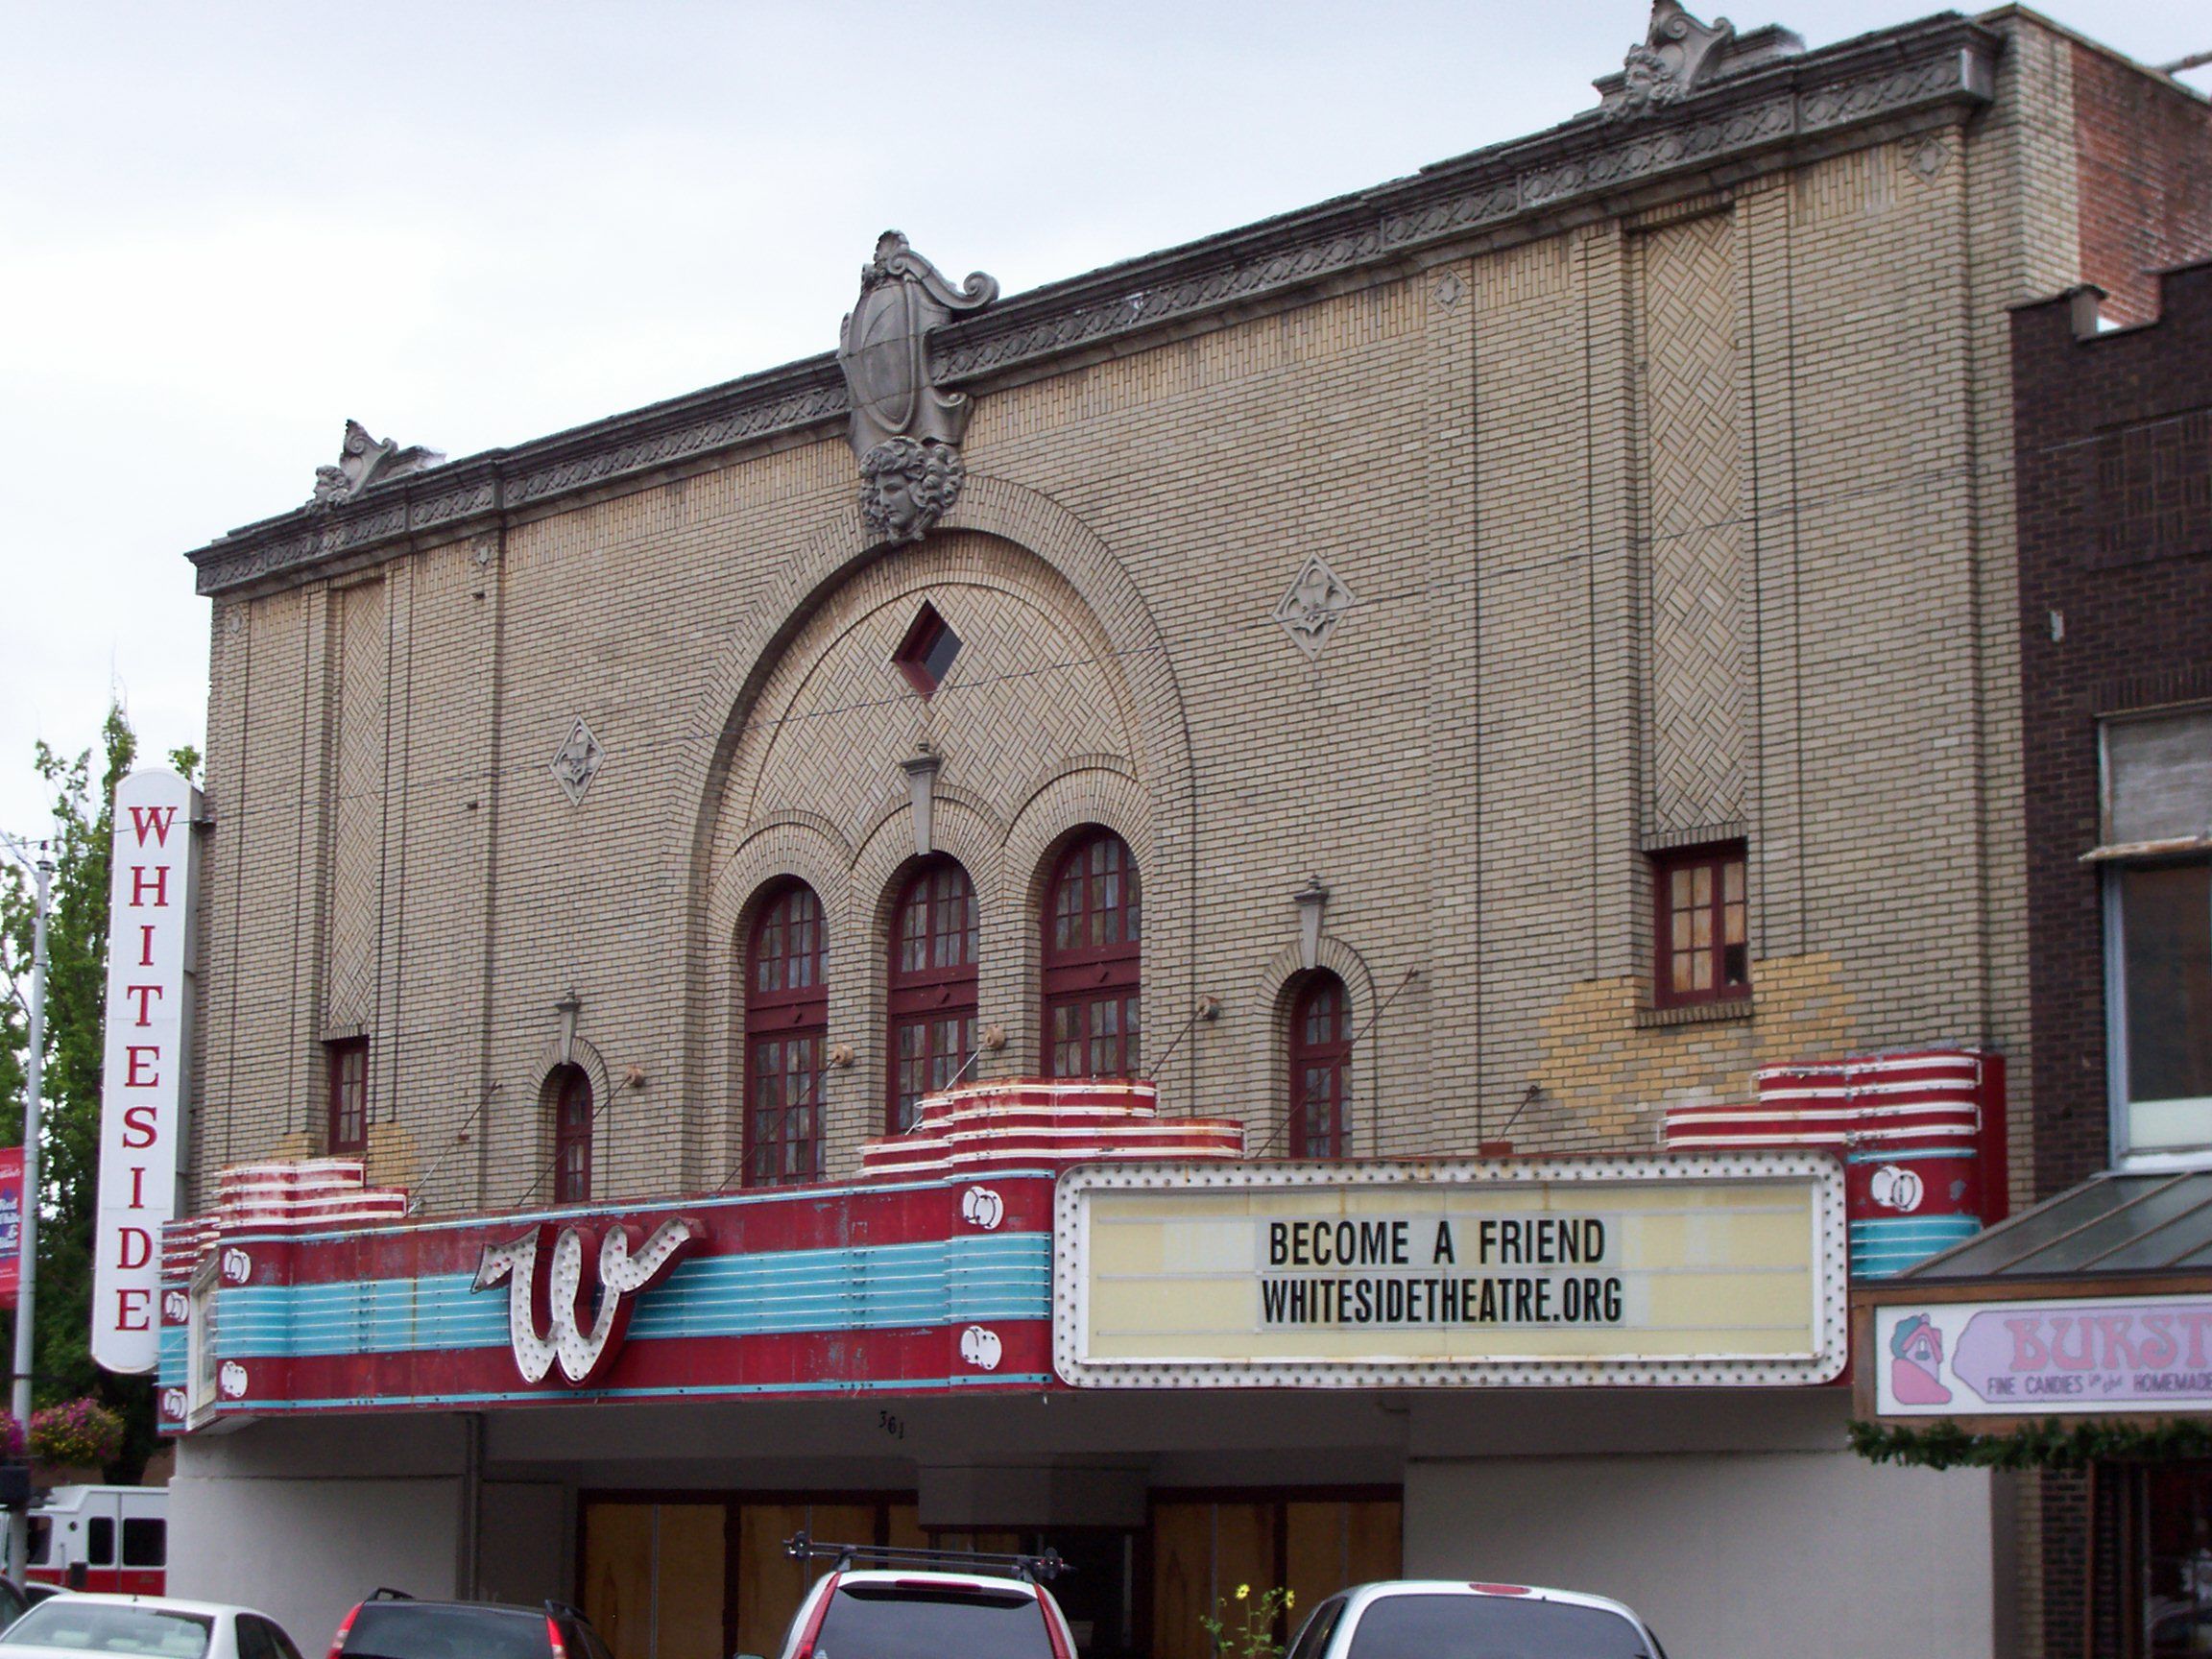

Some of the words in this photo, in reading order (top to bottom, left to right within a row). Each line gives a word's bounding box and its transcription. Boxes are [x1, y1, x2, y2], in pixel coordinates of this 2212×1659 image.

[114, 805, 178, 1332] WHITESIDE
[1270, 1220, 1409, 1265] BECOME
[1432, 1220, 1455, 1264] A
[1479, 1218, 1605, 1264] FRIEND
[1262, 1277, 1623, 1324] WHITESIDETHEATRE.ORG
